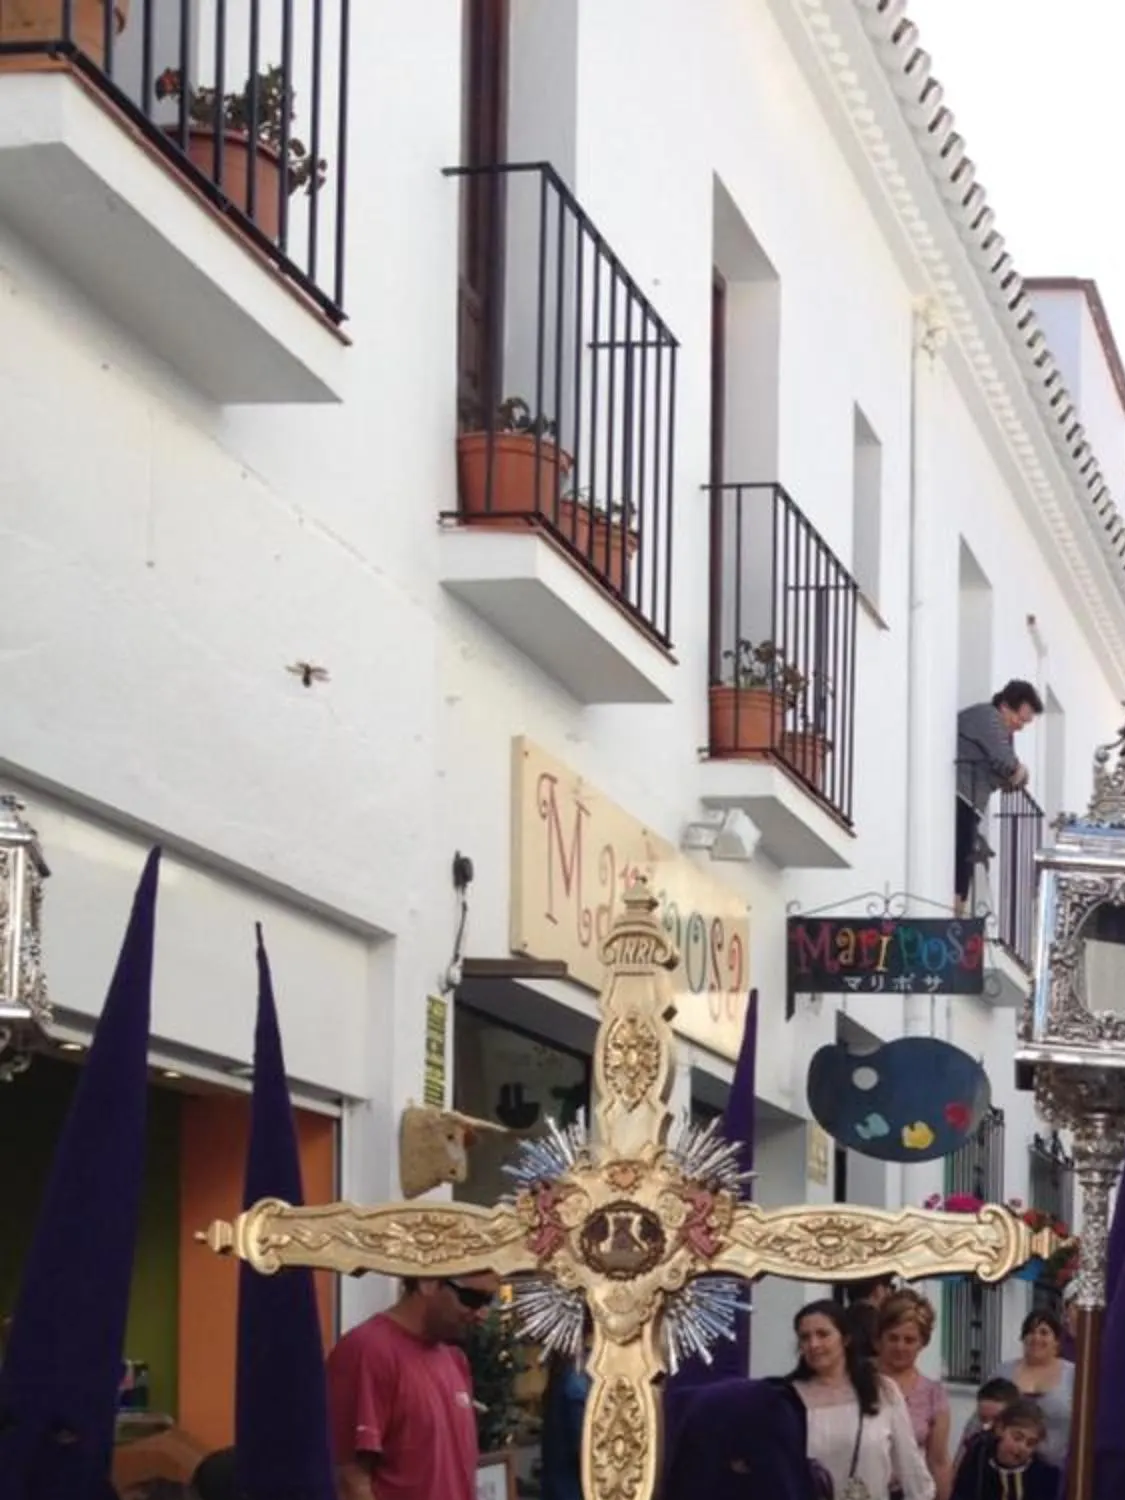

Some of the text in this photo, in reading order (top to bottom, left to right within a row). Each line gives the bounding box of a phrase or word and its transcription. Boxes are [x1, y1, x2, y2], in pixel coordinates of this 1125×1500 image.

[614, 936, 655, 965] INRI
[842, 973, 943, 992] マリポサ
